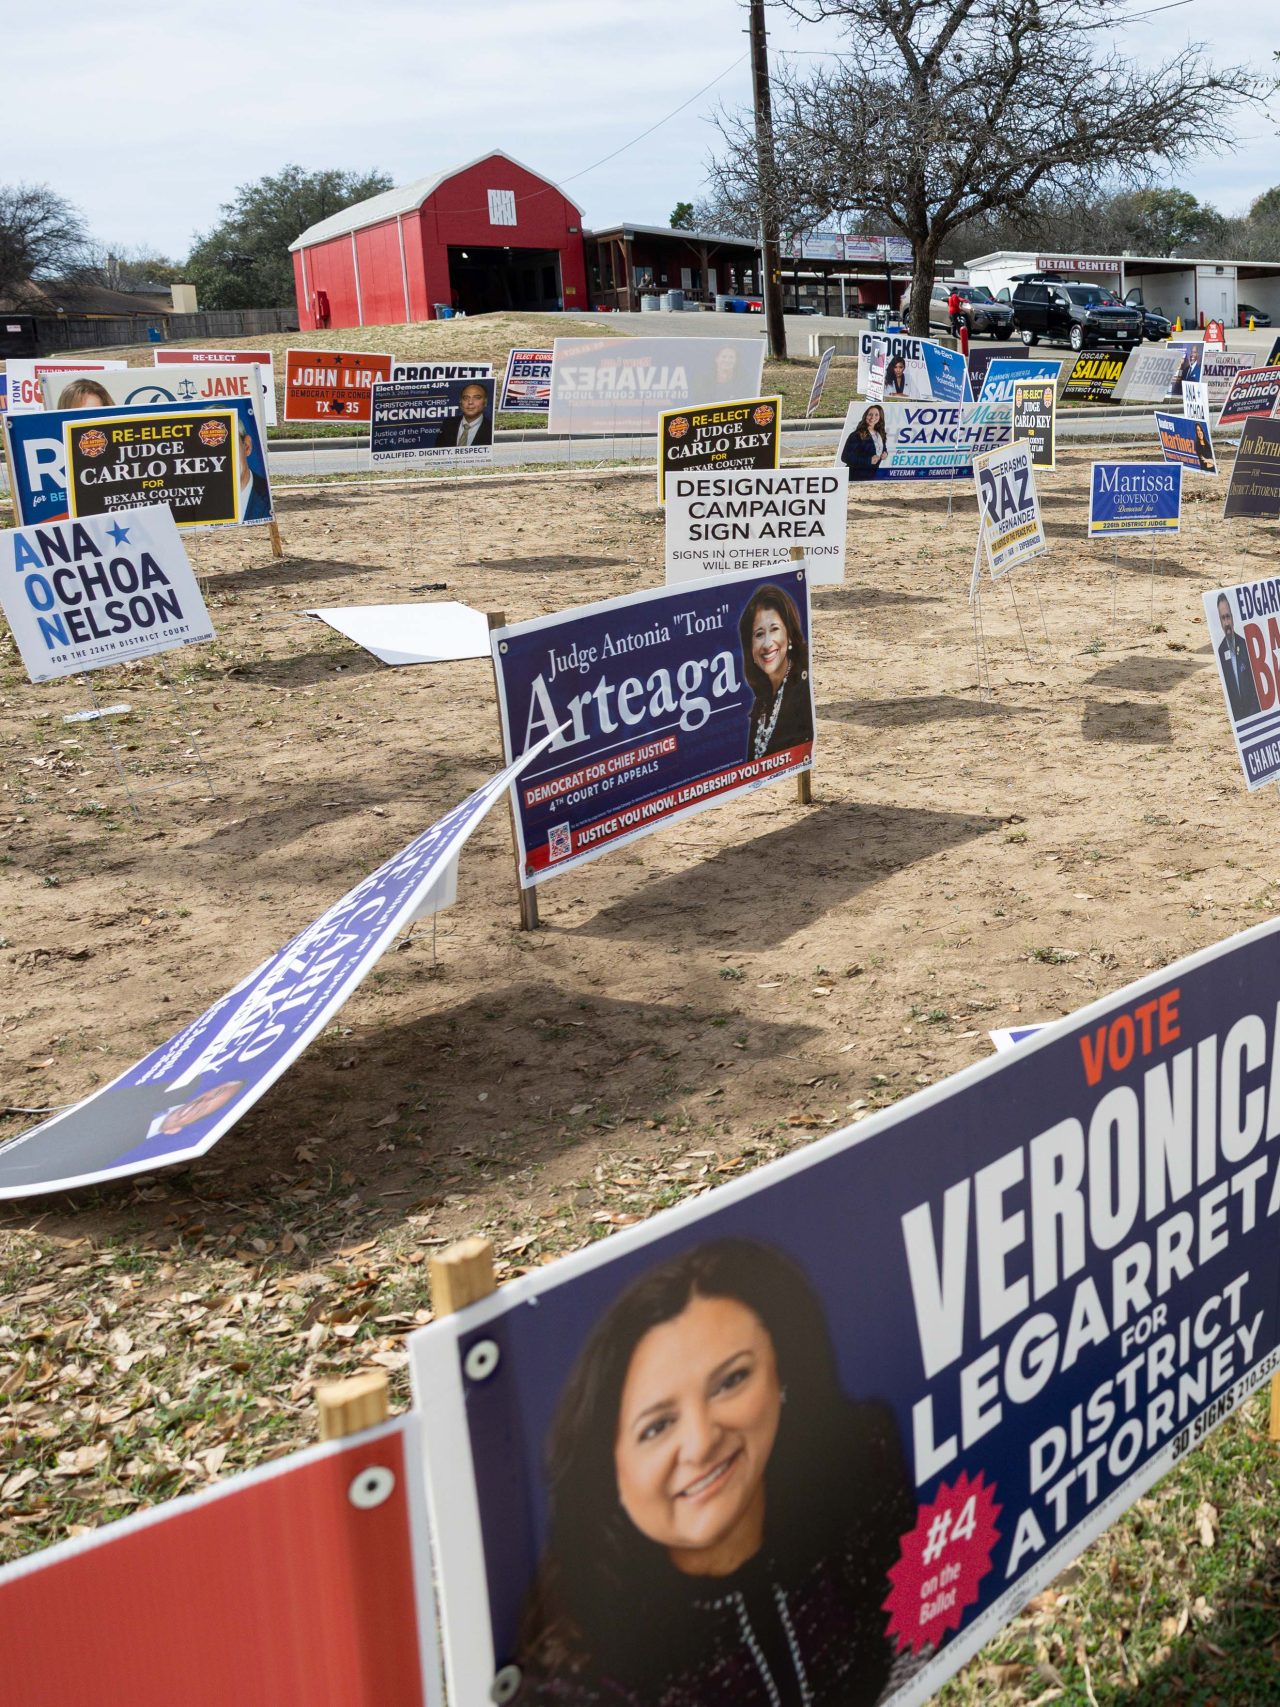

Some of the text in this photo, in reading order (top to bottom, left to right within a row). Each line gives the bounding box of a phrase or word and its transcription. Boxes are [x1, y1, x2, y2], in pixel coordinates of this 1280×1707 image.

[1040, 260, 1118, 271] DETAIL CENTER
[192, 354, 236, 362] RE-ELECT
[200, 376, 251, 398] JANE
[292, 368, 384, 388] JOHN LIRA
[12, 380, 21, 403] TONY
[1023, 389, 1043, 399] RE-ELECT
[1230, 382, 1279, 401] Galindo
[316, 401, 359, 413] TX 35
[375, 406, 459, 422] MCKNIGHT
[1023, 402, 1041, 414] JUDGE
[692, 409, 750, 426] RE-ELECT
[1015, 415, 1052, 428] CARLO KEY
[112, 424, 194, 443] RE-ELECT
[374, 429, 397, 438] Justice
[420, 427, 443, 435] Peace,
[694, 423, 743, 442] JUDGE
[898, 426, 1012, 443] SANCHEZ
[116, 441, 185, 463] JUDGE
[373, 451, 416, 461] QUALIFIED.
[418, 449, 453, 457] DIGNITY.
[667, 433, 772, 460] CARLO KEY
[711, 453, 727, 461] FOR
[891, 455, 928, 466] BEXAR
[928, 454, 970, 465] COUNTY
[1000, 455, 1027, 475] ERASMO
[80, 456, 226, 486] CARLO KEY
[889, 469, 916, 477] VETERAN
[1099, 467, 1174, 492] Marissa
[142, 479, 164, 488] FOR
[677, 476, 839, 497] DESIGNATED
[32, 496, 47, 507] for
[104, 486, 205, 505] BEXAR COUNTY
[1113, 494, 1158, 504] GIOVENCO
[688, 499, 826, 519] CAMPAIGN
[689, 520, 825, 541] SIGN AREA
[13, 523, 102, 572] ANA
[702, 560, 749, 570] WILL BE
[25, 552, 170, 612] OCHOA
[37, 588, 184, 650] NELSON
[52, 625, 190, 664] FOR THE 226TH DISTRICT COURT
[547, 604, 730, 683] Judge Antonia "Toni"
[524, 651, 742, 754] Arteaga
[526, 738, 676, 805] DEMOCRAT FOR CHIEF JUSTICE
[577, 821, 617, 848] JUSTICE
[618, 809, 641, 831] YOU
[642, 796, 677, 823] KNOW.
[678, 771, 738, 803] LEADERSHIP
[738, 764, 760, 780] YOU
[761, 751, 792, 773] TRUST.
[1079, 987, 1181, 1087] VOTE
[1121, 1302, 1167, 1358] FOR
[1030, 1271, 1249, 1494] DISTRICT
[1006, 1310, 1265, 1579] ATTORNEY
[922, 1495, 977, 1565] #4
[920, 1561, 961, 1599] on the
[919, 1587, 957, 1626] Ballot
